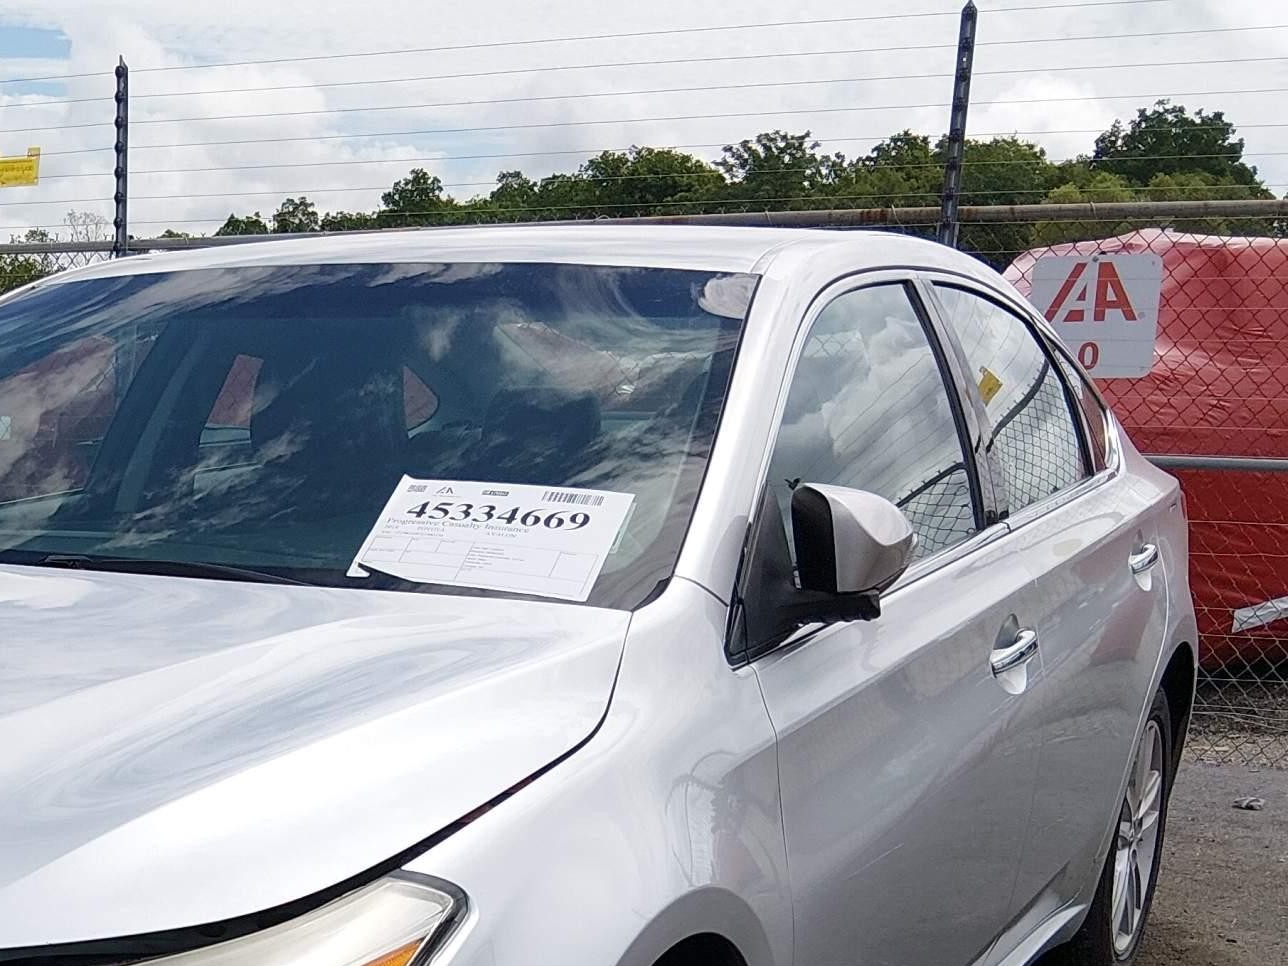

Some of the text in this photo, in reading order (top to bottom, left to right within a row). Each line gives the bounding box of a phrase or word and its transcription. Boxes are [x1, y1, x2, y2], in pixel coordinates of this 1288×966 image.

[1077, 341, 1100, 370] 0
[386, 516, 441, 528] Progressive
[484, 523, 531, 534] Insurance
[406, 500, 591, 531] 45334669
